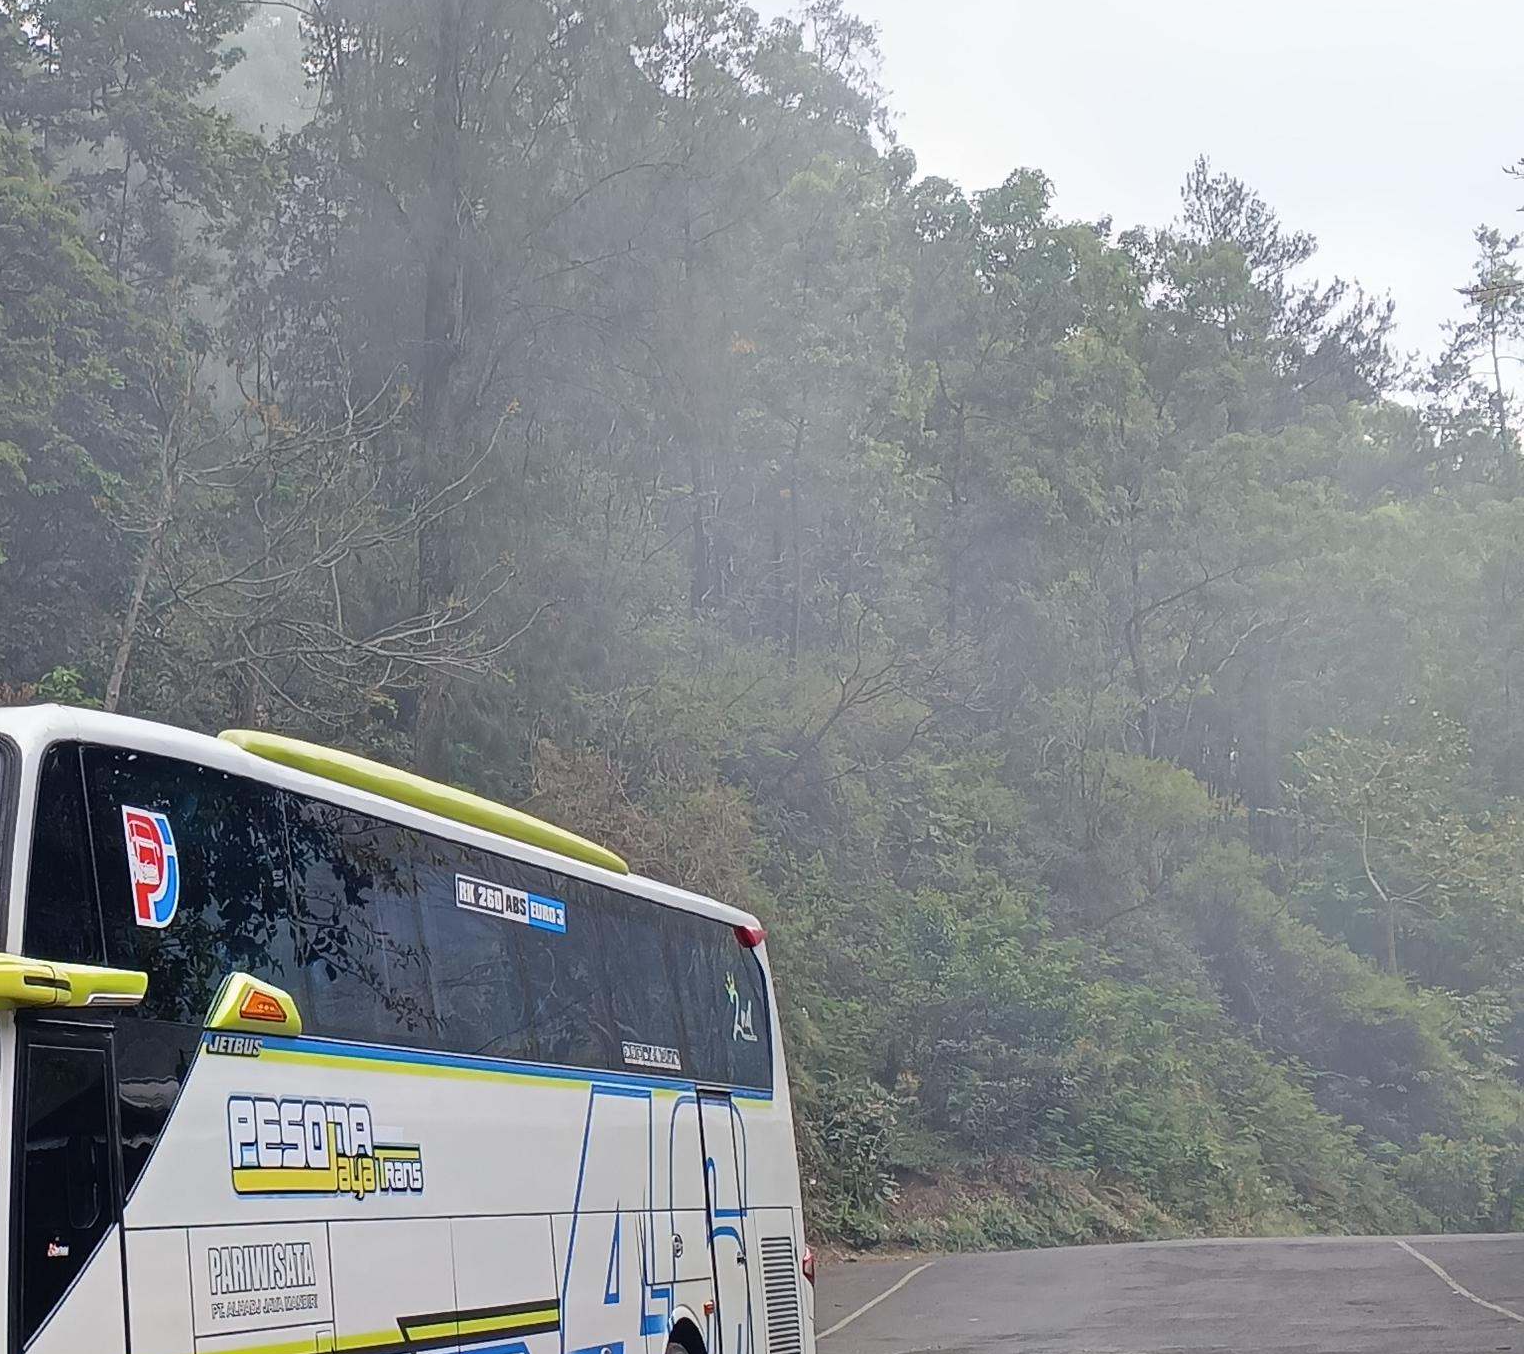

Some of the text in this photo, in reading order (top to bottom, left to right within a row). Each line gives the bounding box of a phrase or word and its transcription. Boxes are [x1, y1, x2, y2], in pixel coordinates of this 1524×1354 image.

[458, 880, 565, 926] RK 260 ABS EURO 3
[209, 1036, 263, 1056] JETBUS
[228, 1095, 374, 1170] PESONA
[208, 1242, 316, 1295] PARIWISATA
